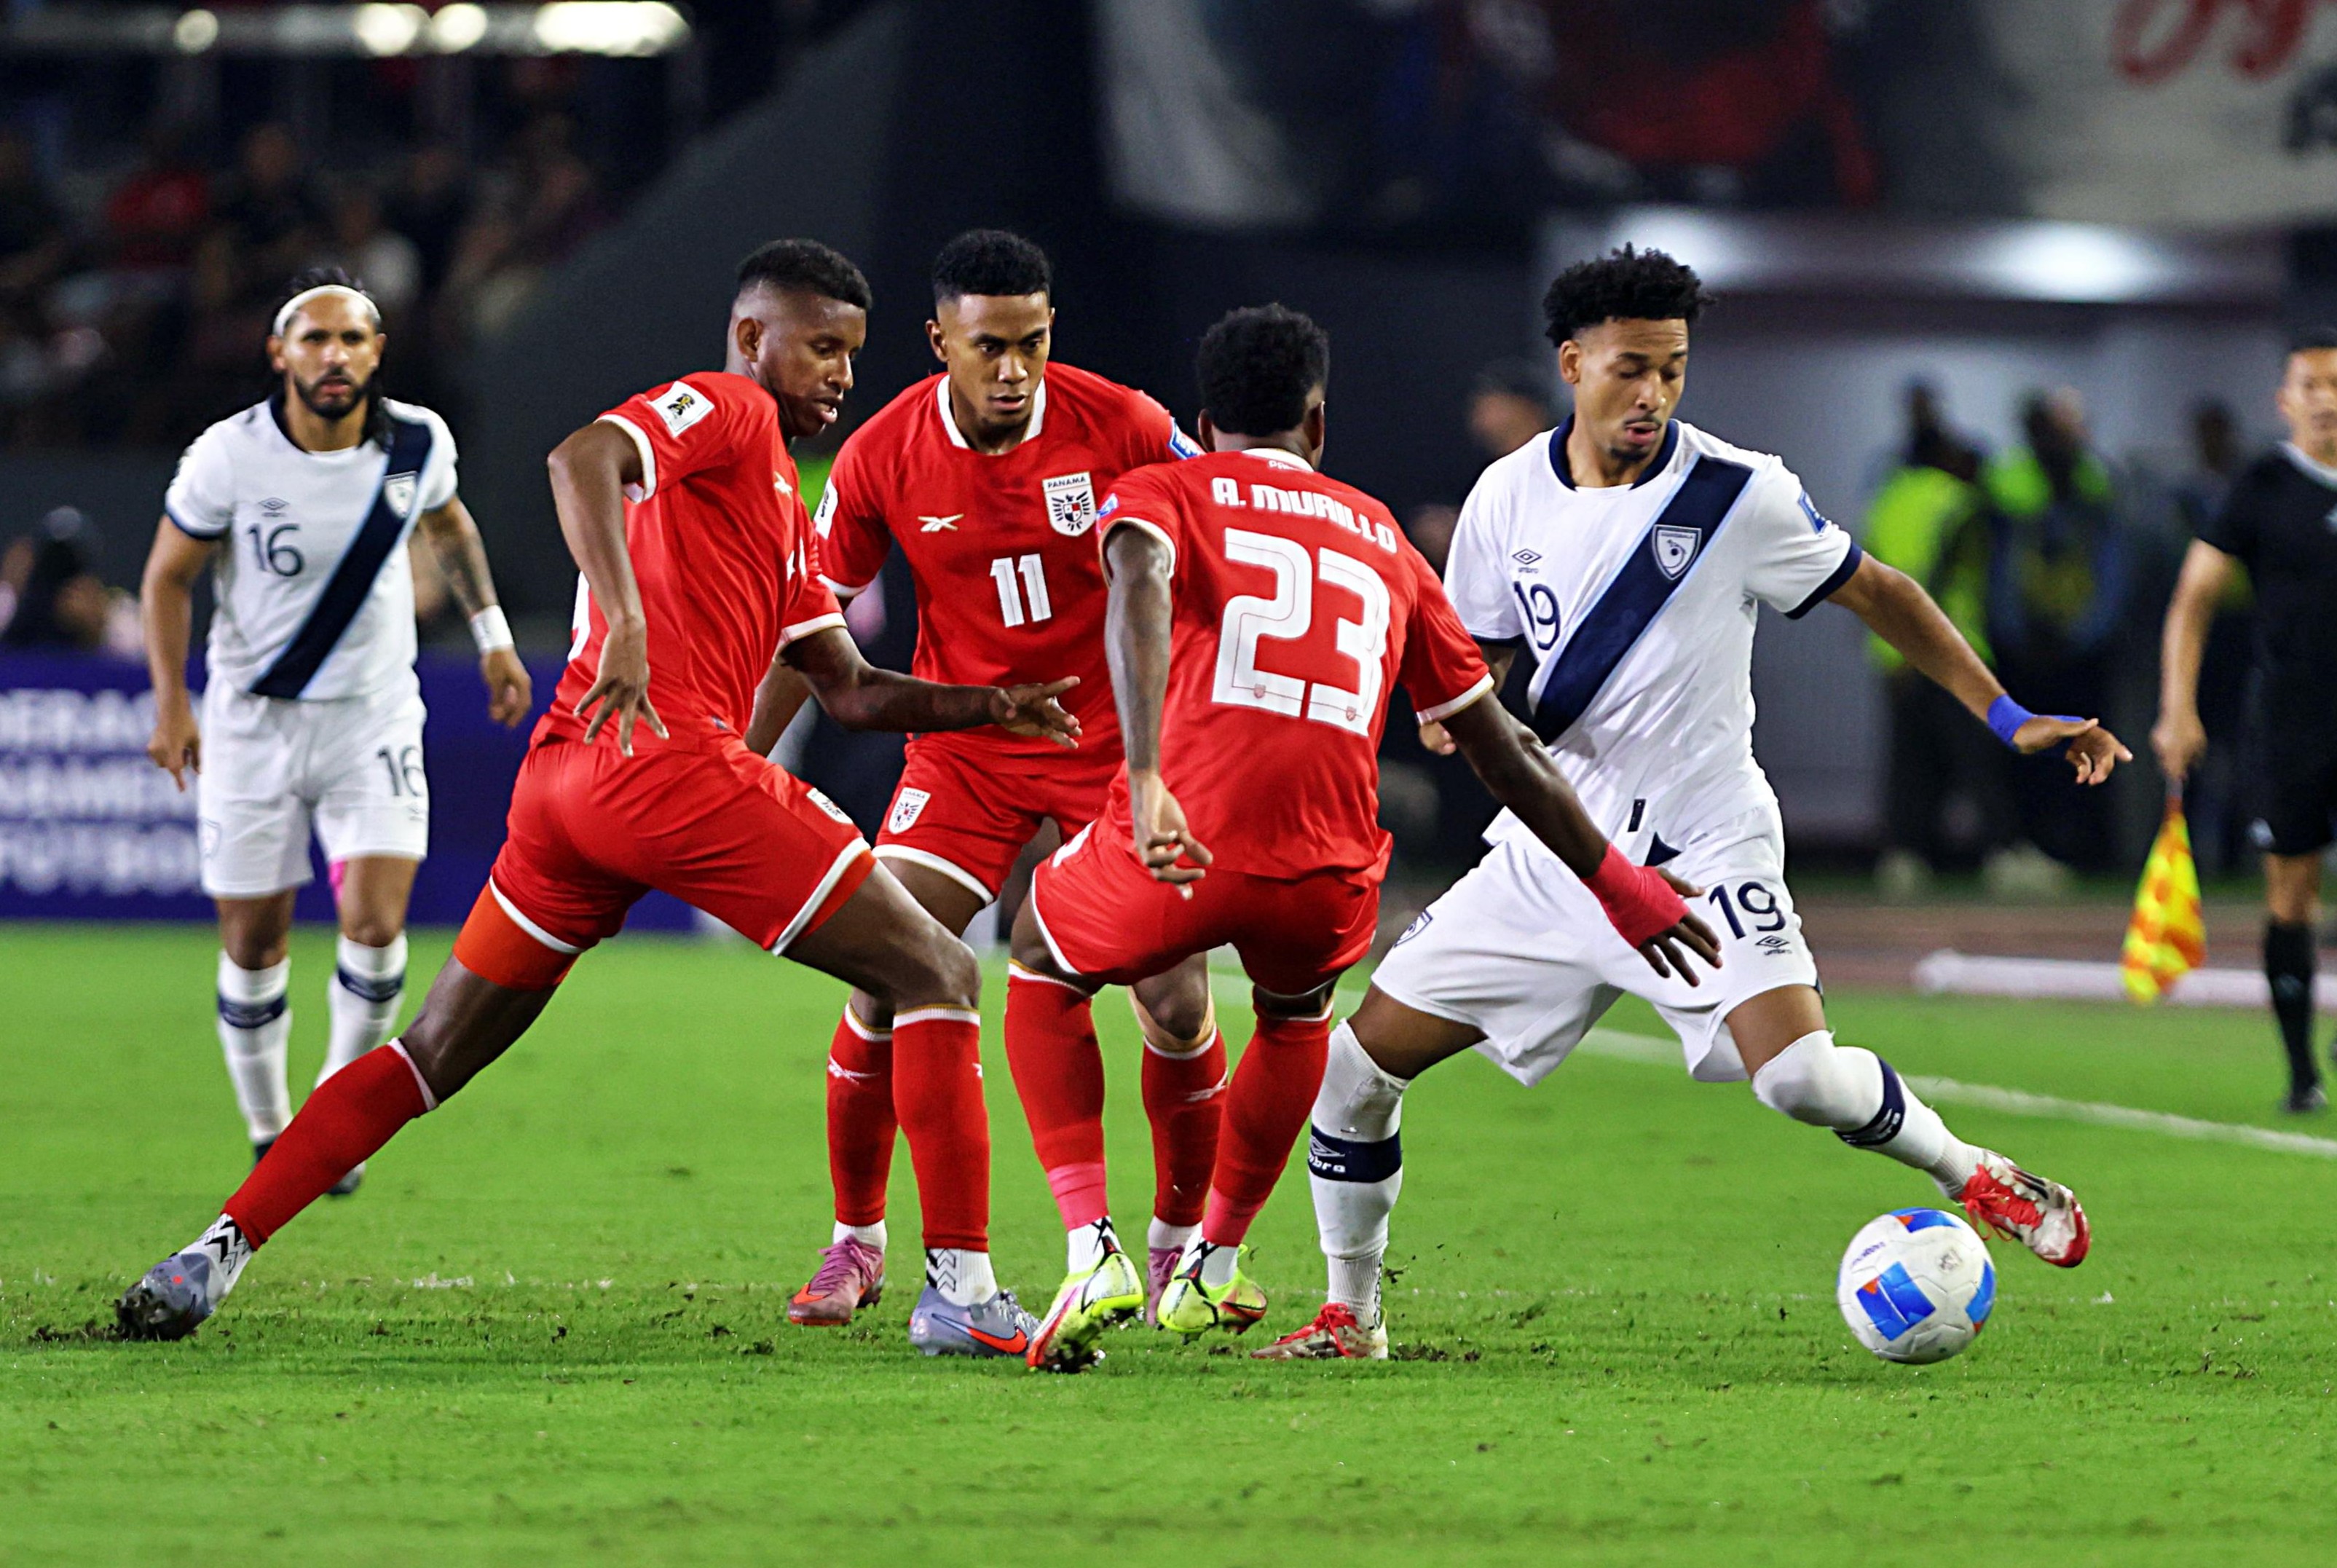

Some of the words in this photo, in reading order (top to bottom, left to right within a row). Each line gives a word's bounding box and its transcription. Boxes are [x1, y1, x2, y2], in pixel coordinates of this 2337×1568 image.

[1047, 476, 1086, 489] PANAMA
[1212, 477, 1246, 506] A.
[1250, 484, 1398, 554] MURILLO
[246, 523, 305, 577] 16
[990, 553, 1052, 628] 11
[1513, 580, 1561, 650] 19
[1211, 527, 1390, 738] 23
[376, 744, 425, 797] 16
[1708, 880, 1786, 940] 19
